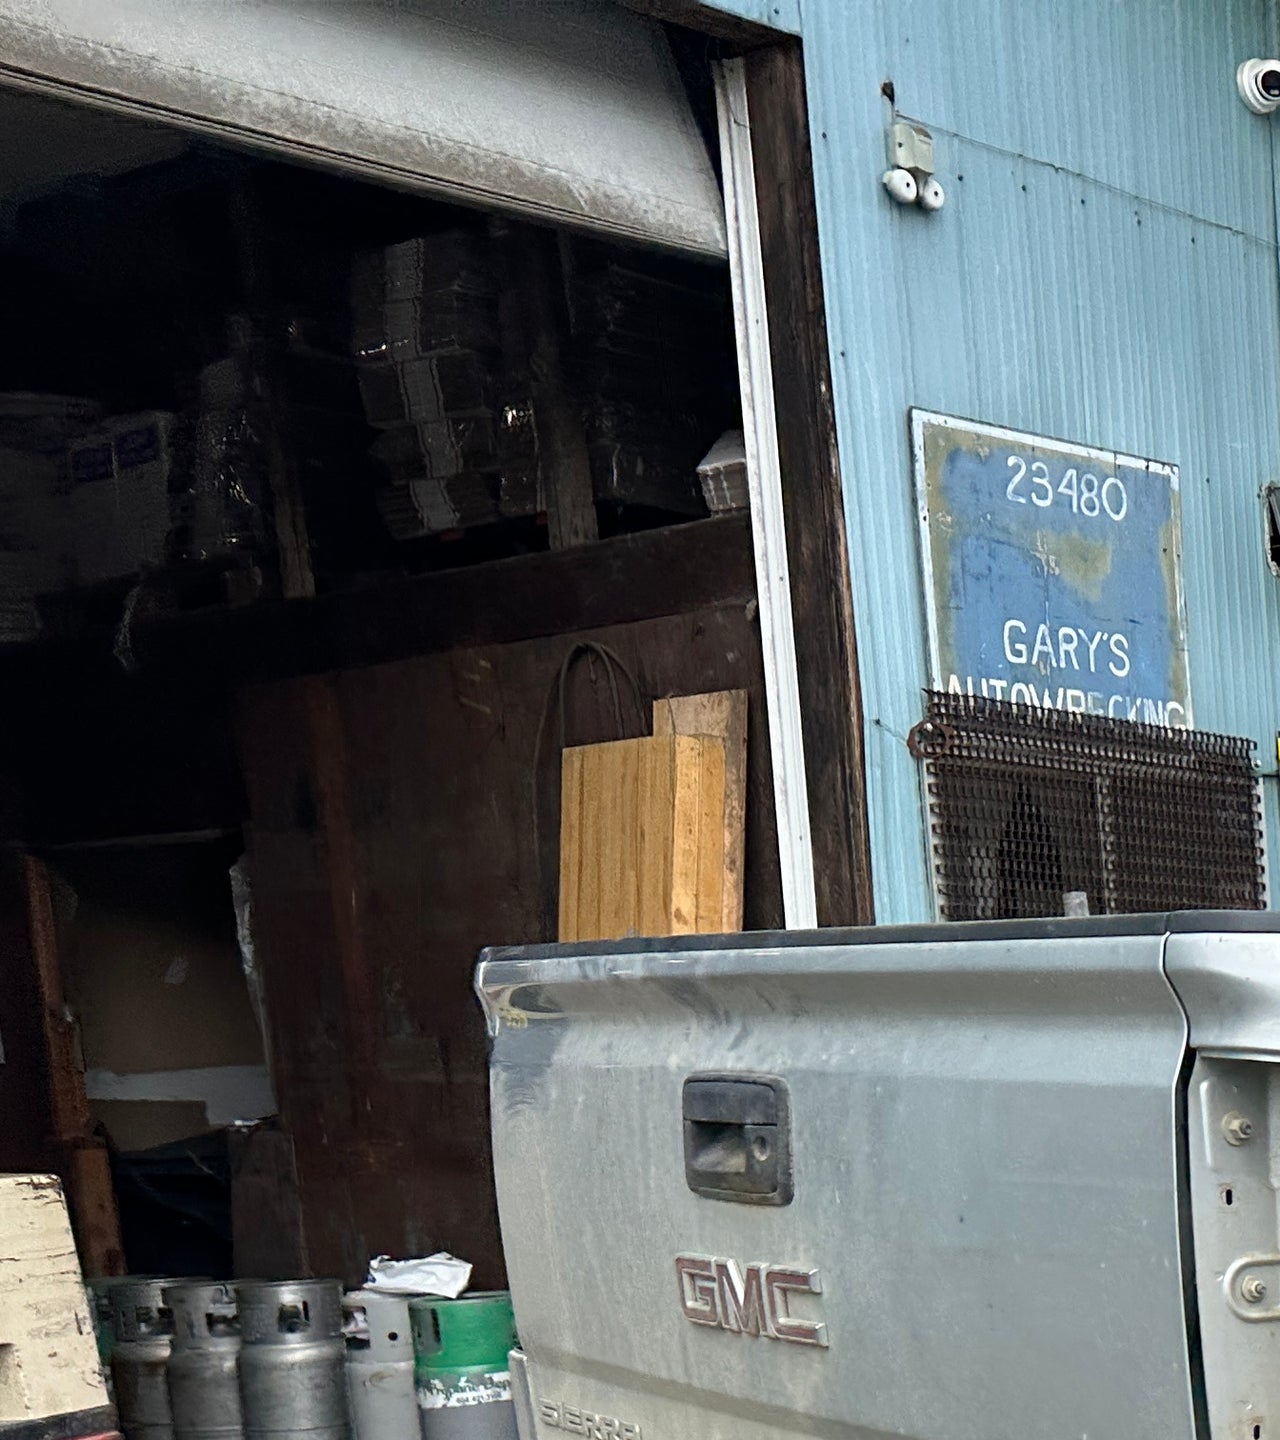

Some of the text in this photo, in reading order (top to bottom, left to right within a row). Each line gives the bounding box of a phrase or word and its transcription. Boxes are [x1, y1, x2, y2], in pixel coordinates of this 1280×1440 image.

[1006, 455, 1128, 521] 23480
[1003, 619, 1131, 678] GARY'S
[674, 1251, 830, 1349] GMC
